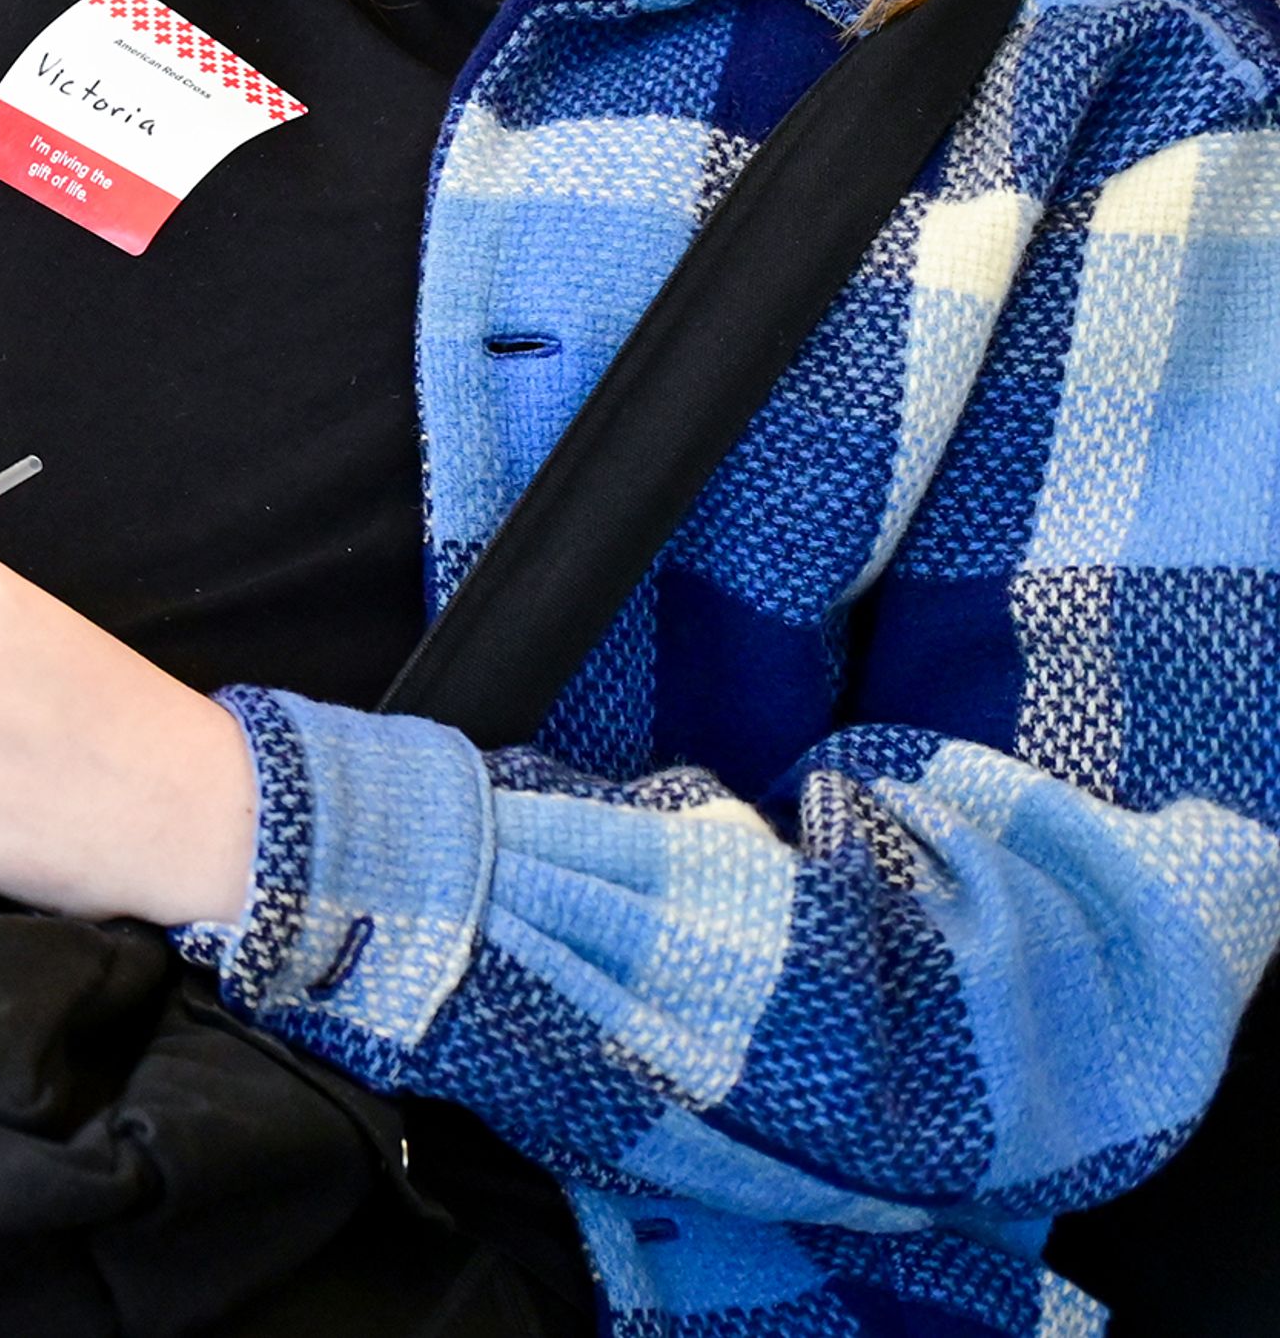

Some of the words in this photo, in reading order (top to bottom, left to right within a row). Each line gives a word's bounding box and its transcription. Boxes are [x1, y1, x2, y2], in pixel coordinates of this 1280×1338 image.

[38, 52, 155, 136] Victoria
[114, 38, 162, 70] American
[162, 65, 184, 82] Red
[182, 78, 211, 99] Cross
[28, 162, 52, 182] gift
[51, 174, 69, 189] of
[65, 179, 87, 203] life.
[30, 134, 51, 156] I'm
[50, 149, 90, 180] giving
[89, 168, 113, 190] the
